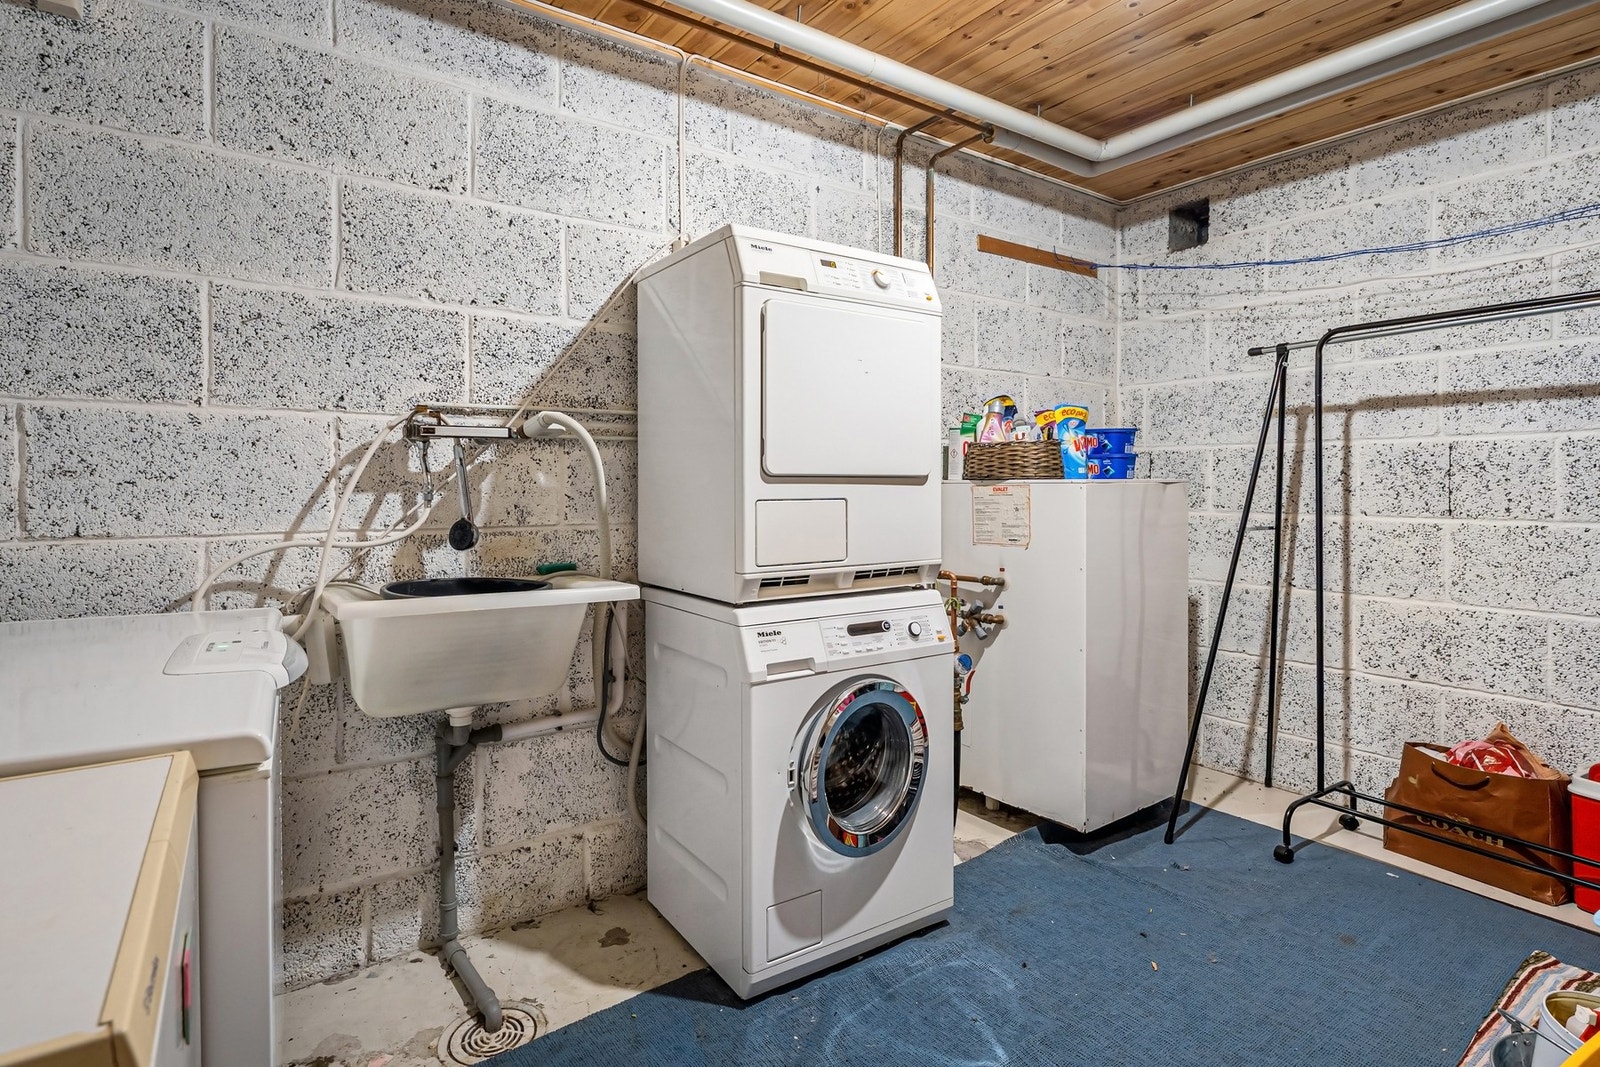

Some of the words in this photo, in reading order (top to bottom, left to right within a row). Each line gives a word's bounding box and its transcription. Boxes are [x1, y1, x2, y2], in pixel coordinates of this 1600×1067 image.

[750, 243, 773, 252] Miele
[1061, 408, 1076, 416] eco
[1086, 437, 1098, 447] MO
[1087, 464, 1099, 474] MO
[757, 630, 782, 638] Miele
[1416, 815, 1505, 849] COACH
